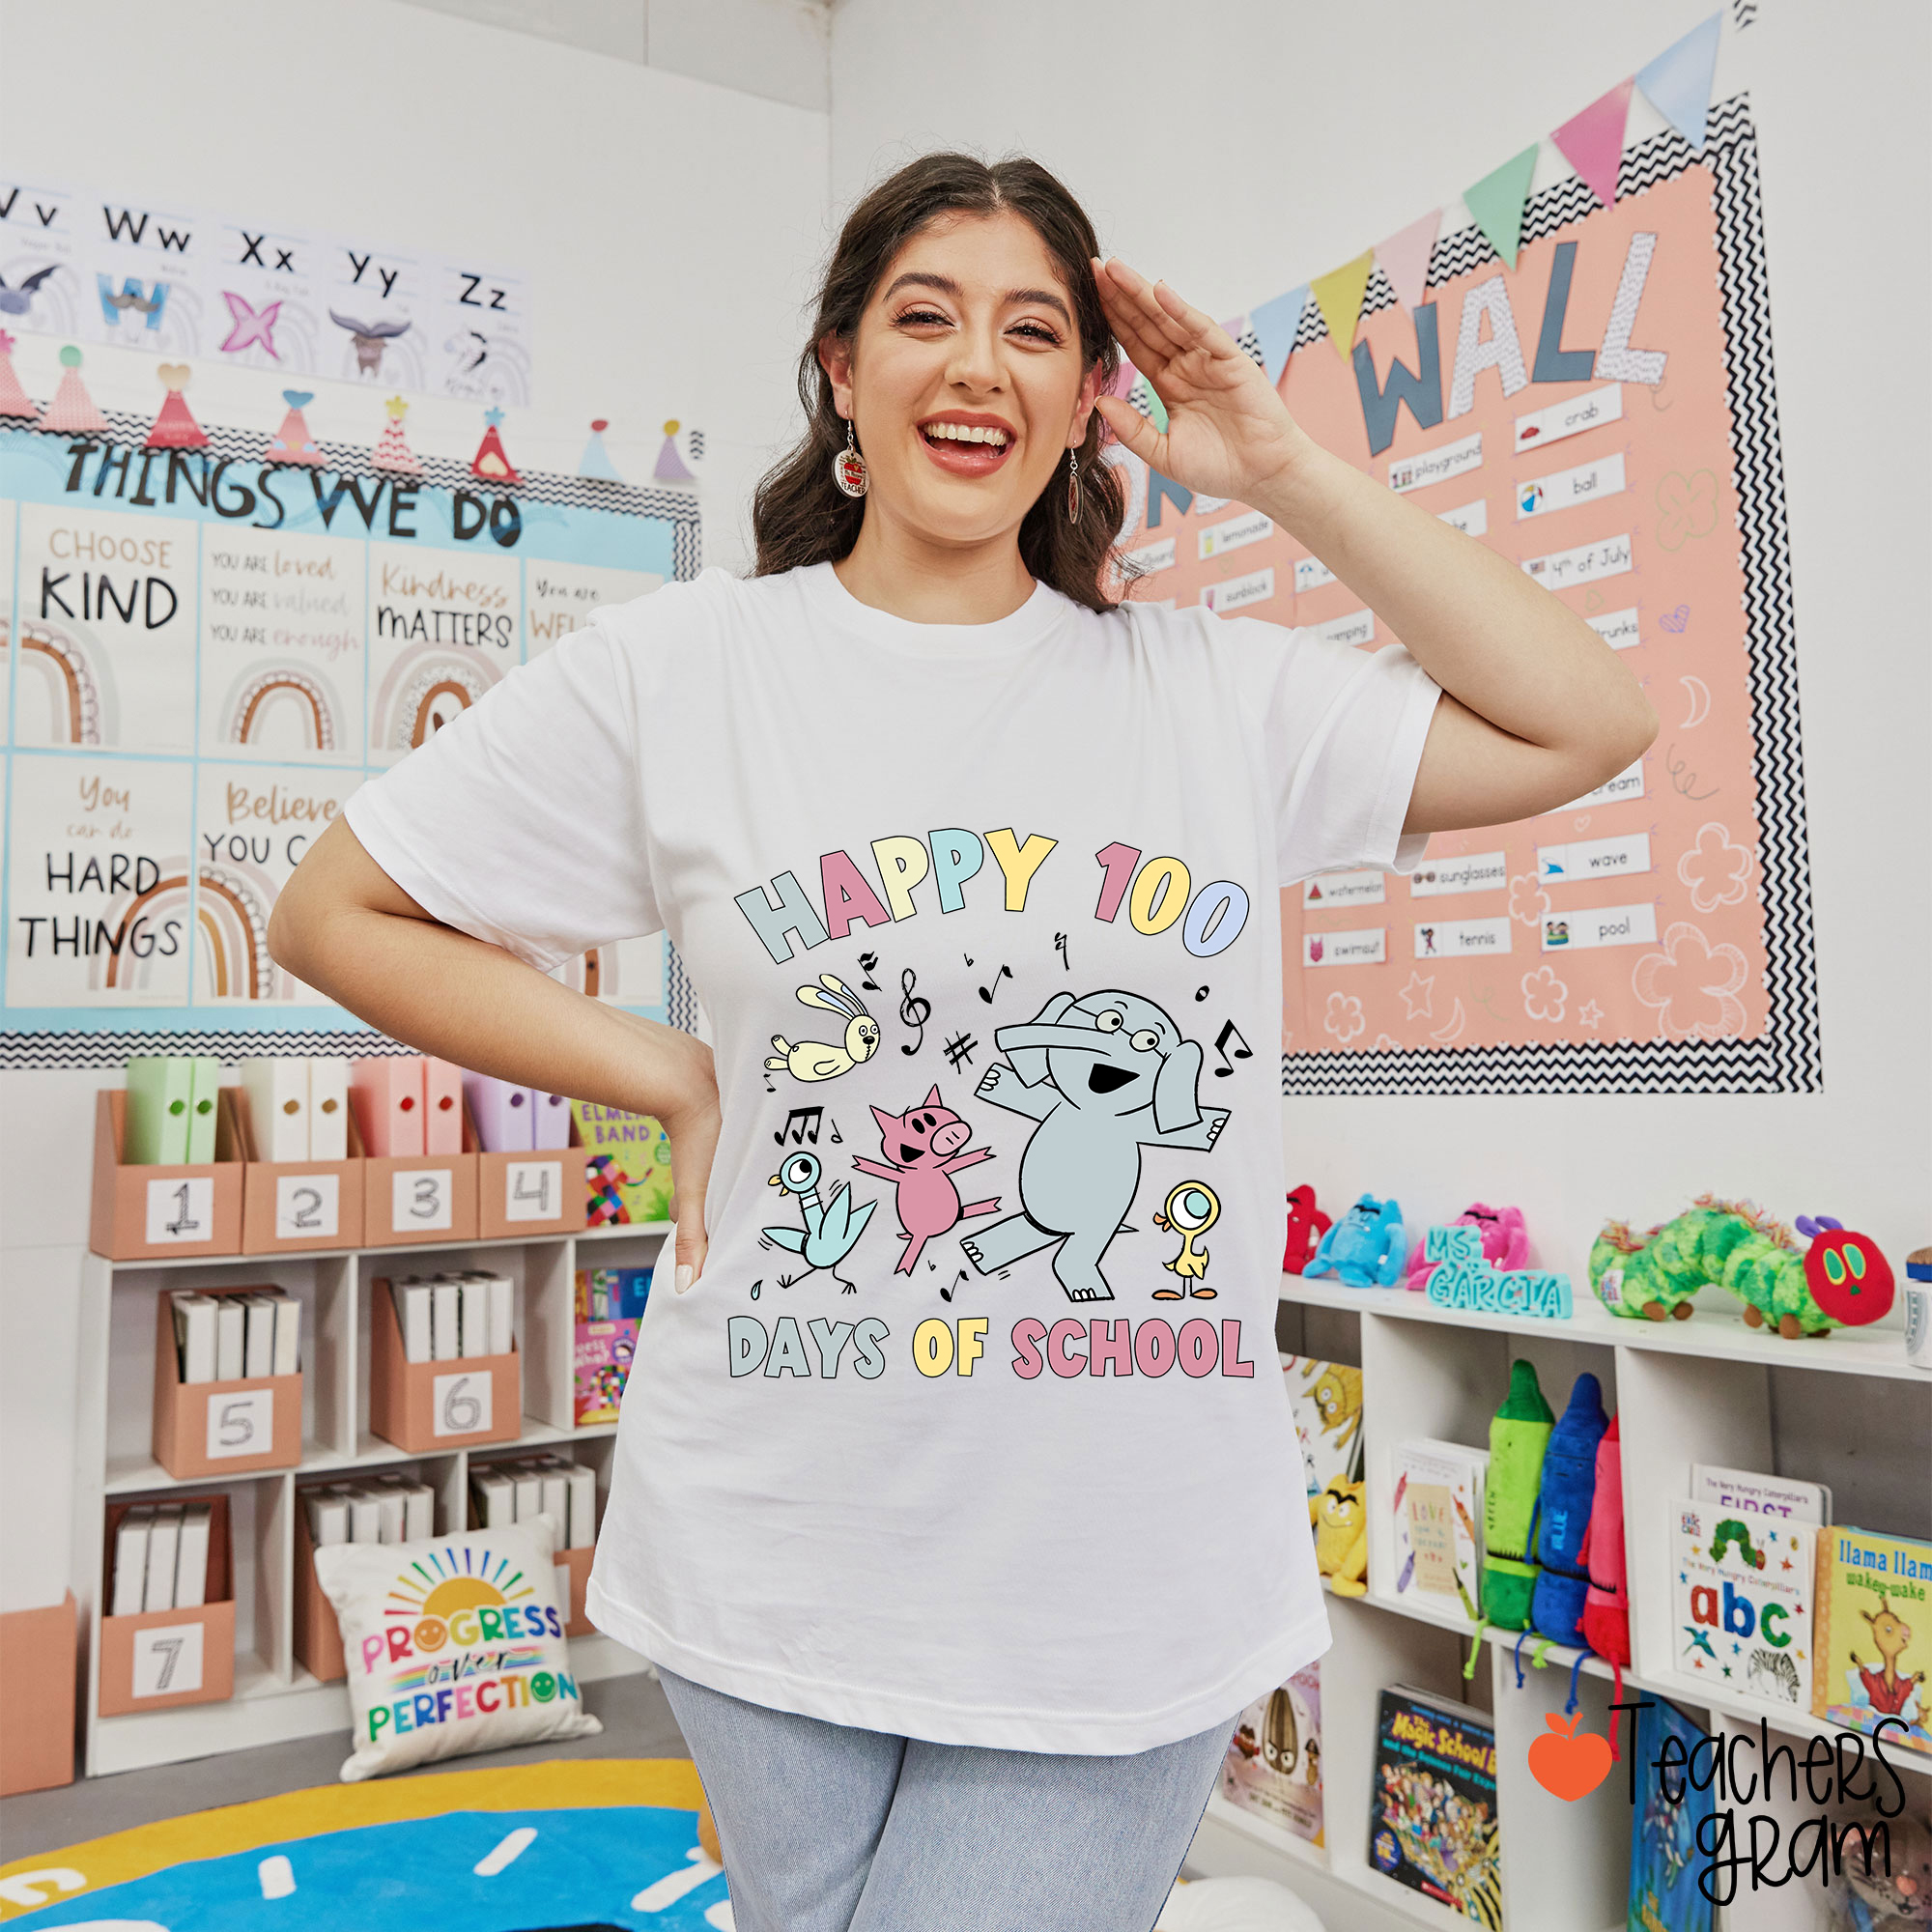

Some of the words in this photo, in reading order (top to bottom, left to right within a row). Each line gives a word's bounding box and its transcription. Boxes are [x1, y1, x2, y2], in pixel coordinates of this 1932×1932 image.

[103, 206, 149, 243] W
[158, 228, 190, 252] w
[241, 232, 265, 267] X
[276, 248, 294, 271] x
[349, 251, 371, 283] Y
[380, 268, 398, 298] y
[460, 272, 481, 306] Z
[490, 289, 506, 310] z
[1352, 232, 1668, 457] WALL
[1565, 403, 1599, 426] crab
[1415, 442, 1482, 480] playground
[65, 444, 284, 528] THINGS
[309, 469, 418, 537] WE
[452, 491, 523, 548] DO
[1574, 472, 1597, 495] ball
[49, 529, 172, 568] CHOOSE
[1223, 519, 1269, 543] lemonade
[212, 553, 240, 570] YOU
[243, 554, 267, 572] ARE
[273, 550, 335, 579] loved
[1577, 553, 1594, 573] of
[1600, 546, 1632, 571] July
[42, 566, 178, 629] KIND
[211, 588, 239, 606] YOU
[243, 590, 266, 610] ARE
[273, 589, 350, 616] valued
[382, 562, 508, 609] Kindness
[1226, 580, 1267, 603] sunblock
[211, 623, 239, 642] YOU
[243, 626, 266, 645] ARE
[273, 626, 359, 663] enough
[377, 605, 512, 647] MATTERS
[79, 776, 129, 811] You
[226, 781, 337, 825] Believe
[67, 824, 99, 839] can
[109, 820, 132, 839] do
[204, 834, 270, 865] YOU
[1589, 851, 1628, 868] wave
[46, 852, 159, 895] HARD
[1328, 882, 1383, 897] watermelon
[1439, 865, 1506, 887] sunglasses
[734, 827, 1059, 965] HAPPY
[1094, 840, 1249, 957] 100
[18, 915, 182, 957] THINGS
[1459, 931, 1496, 947] tennis
[1599, 917, 1631, 940] pool
[595, 1125, 650, 1144] BAND
[165, 1182, 199, 1236] 1
[290, 1187, 323, 1229] 2
[410, 1179, 440, 1219] 3
[513, 1170, 549, 1212] 4
[1429, 1267, 1562, 1318] GARCIA
[727, 1315, 890, 1378] DAYS
[913, 1317, 989, 1378] OF
[1010, 1318, 1255, 1379] SCHOOL
[218, 1401, 255, 1447] 5
[443, 1378, 481, 1431] 6
[1706, 1477, 1718, 1488] The
[1719, 1480, 1735, 1492] Very
[1737, 1484, 1762, 1497] Hungry
[1764, 1488, 1809, 1504] Caterpillar's
[1412, 1500, 1444, 1523] LOVE
[1839, 1539, 1888, 1572] llama
[1683, 1557, 1695, 1570] The
[1698, 1562, 1716, 1576] Very
[1718, 1568, 1746, 1583] Hungry
[1748, 1575, 1800, 1596] Caterpillar's
[1690, 1580, 1792, 1648] abc
[362, 1605, 561, 1675] PROGRESS
[151, 1637, 186, 1690] 7
[428, 1651, 510, 1684] over
[368, 1672, 579, 1743] PERFECTION
[1391, 1711, 1435, 1749] Magic
[1436, 1727, 1488, 1771] School
